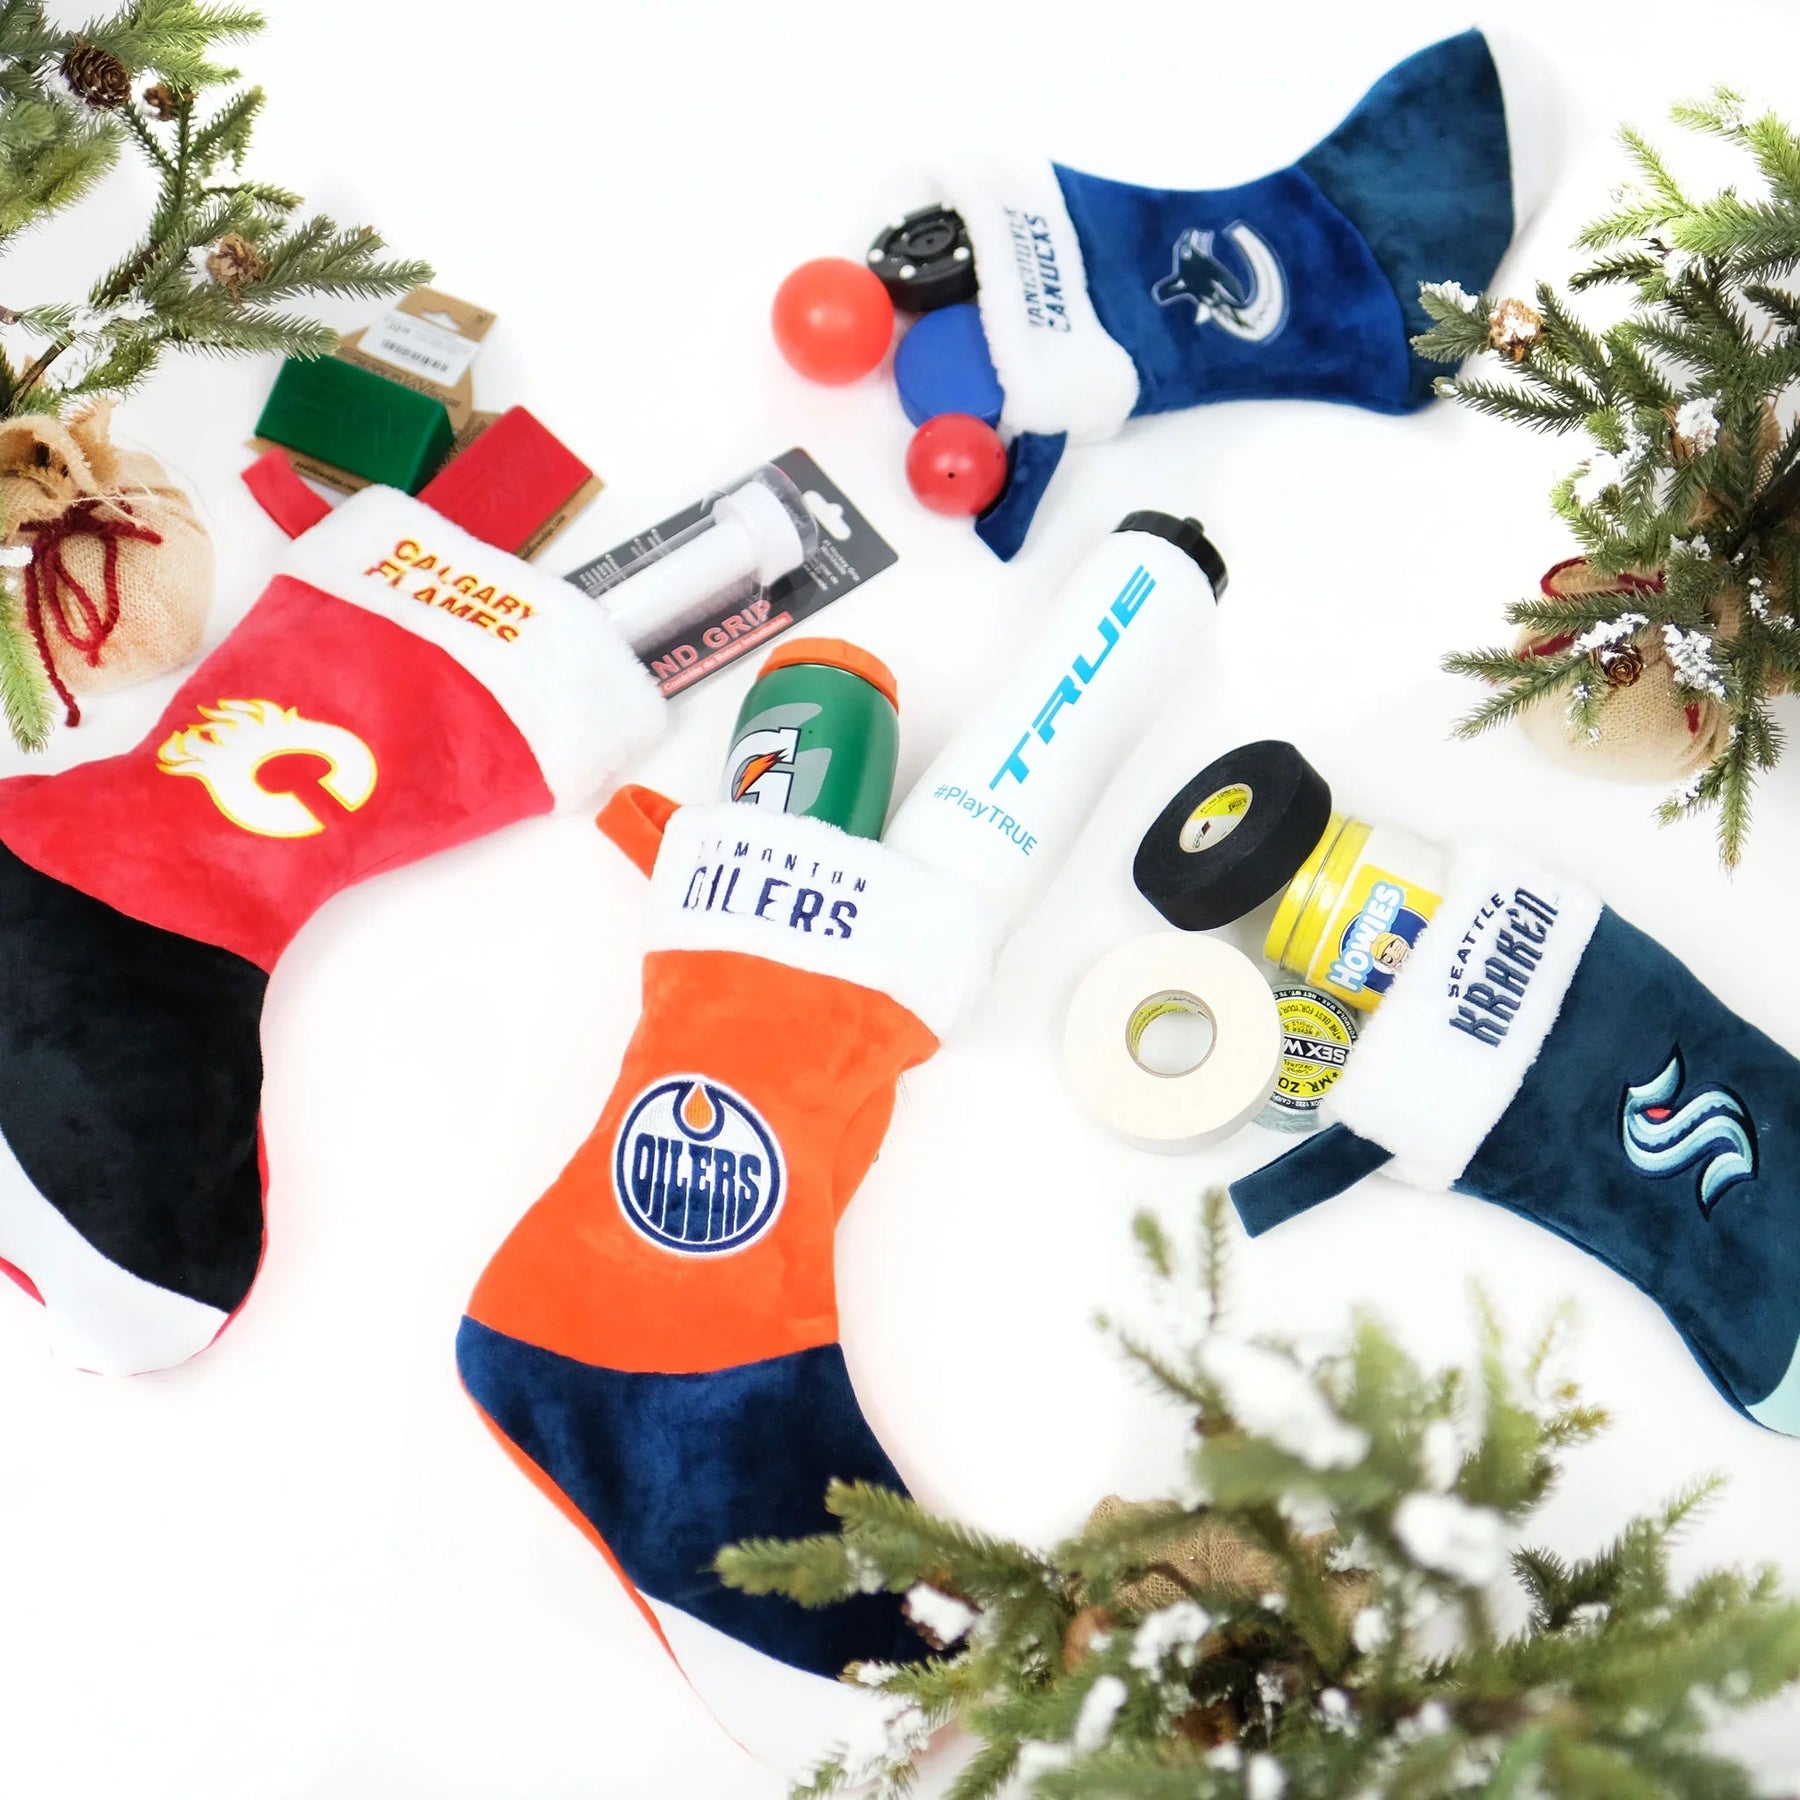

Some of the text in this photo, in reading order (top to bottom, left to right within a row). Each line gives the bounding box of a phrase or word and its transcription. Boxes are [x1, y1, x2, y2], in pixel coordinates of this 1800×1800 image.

[1024, 213, 1071, 332] CANUCKS
[363, 559, 520, 643] FLAMES
[394, 538, 536, 623] CALGARY
[647, 599, 771, 682] ND GRIP
[988, 564, 1157, 785] TRUE
[932, 783, 1038, 857] #PlayTRUE
[682, 863, 858, 939] OILERS
[1328, 883, 1403, 992] HOWIES
[1448, 893, 1505, 998] SEATTLE
[1449, 887, 1559, 1049] KRAKEN
[1281, 1003, 1341, 1037] THE BEST FOR YOUR
[1321, 999, 1337, 1012] WAX
[1336, 1009, 1358, 1040] FORMULA
[1302, 1075, 1333, 1093] MR.
[1305, 1042, 1346, 1065] SEX
[631, 1132, 762, 1242] OILERS
